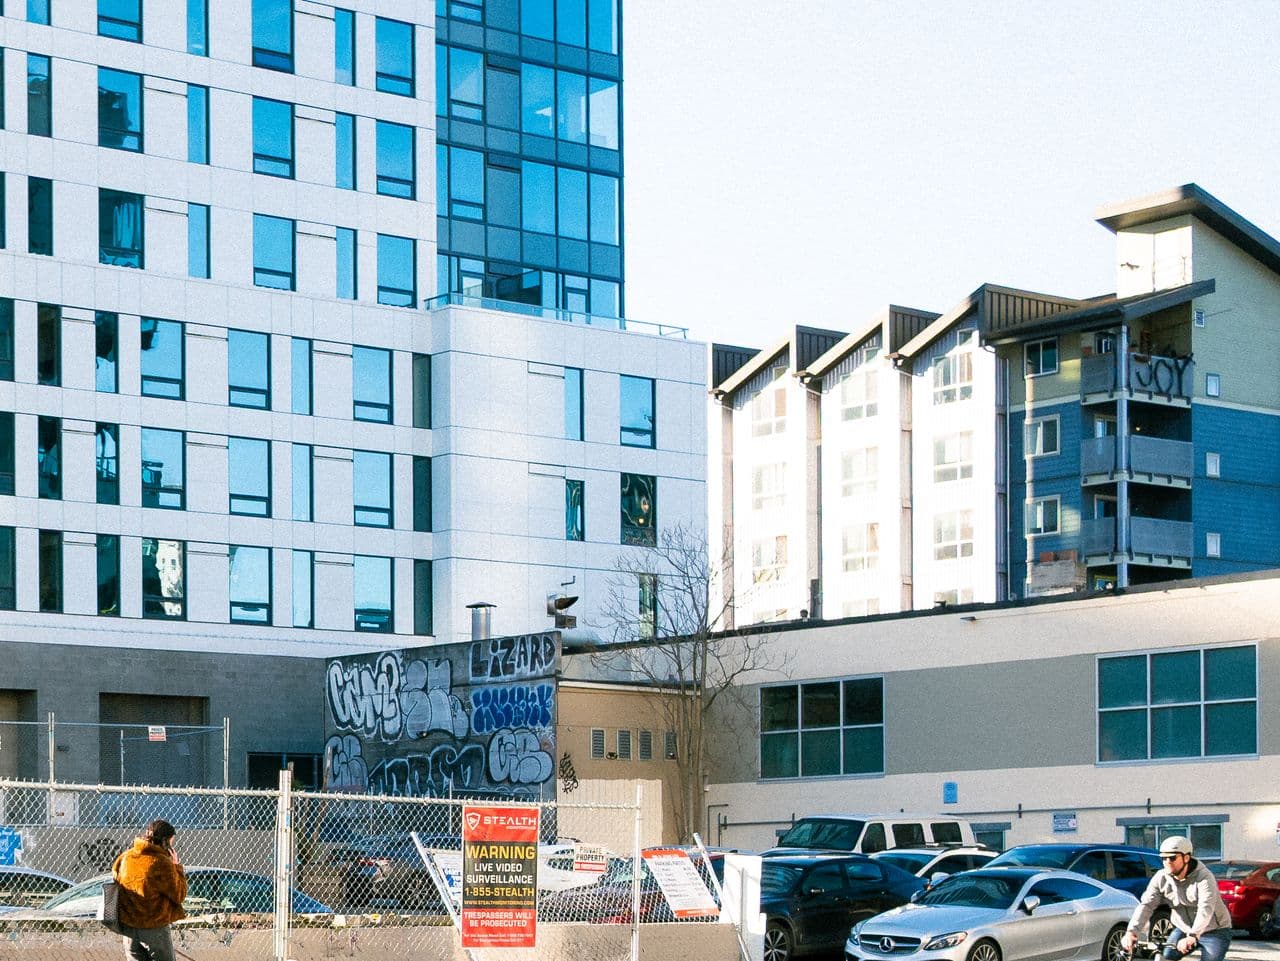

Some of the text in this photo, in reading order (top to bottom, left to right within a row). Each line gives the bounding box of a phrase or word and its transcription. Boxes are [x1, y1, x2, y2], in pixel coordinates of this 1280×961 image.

[1135, 357, 1194, 396] JOY
[483, 816, 537, 826] STEALTH
[465, 845, 535, 860] WARNING
[474, 863, 523, 872] LIVE VIDEO
[466, 874, 533, 884] SURVEILLANCE
[464, 887, 535, 897] 1-855-STEALTH
[464, 911, 533, 919] TRESPASSERS WILL
